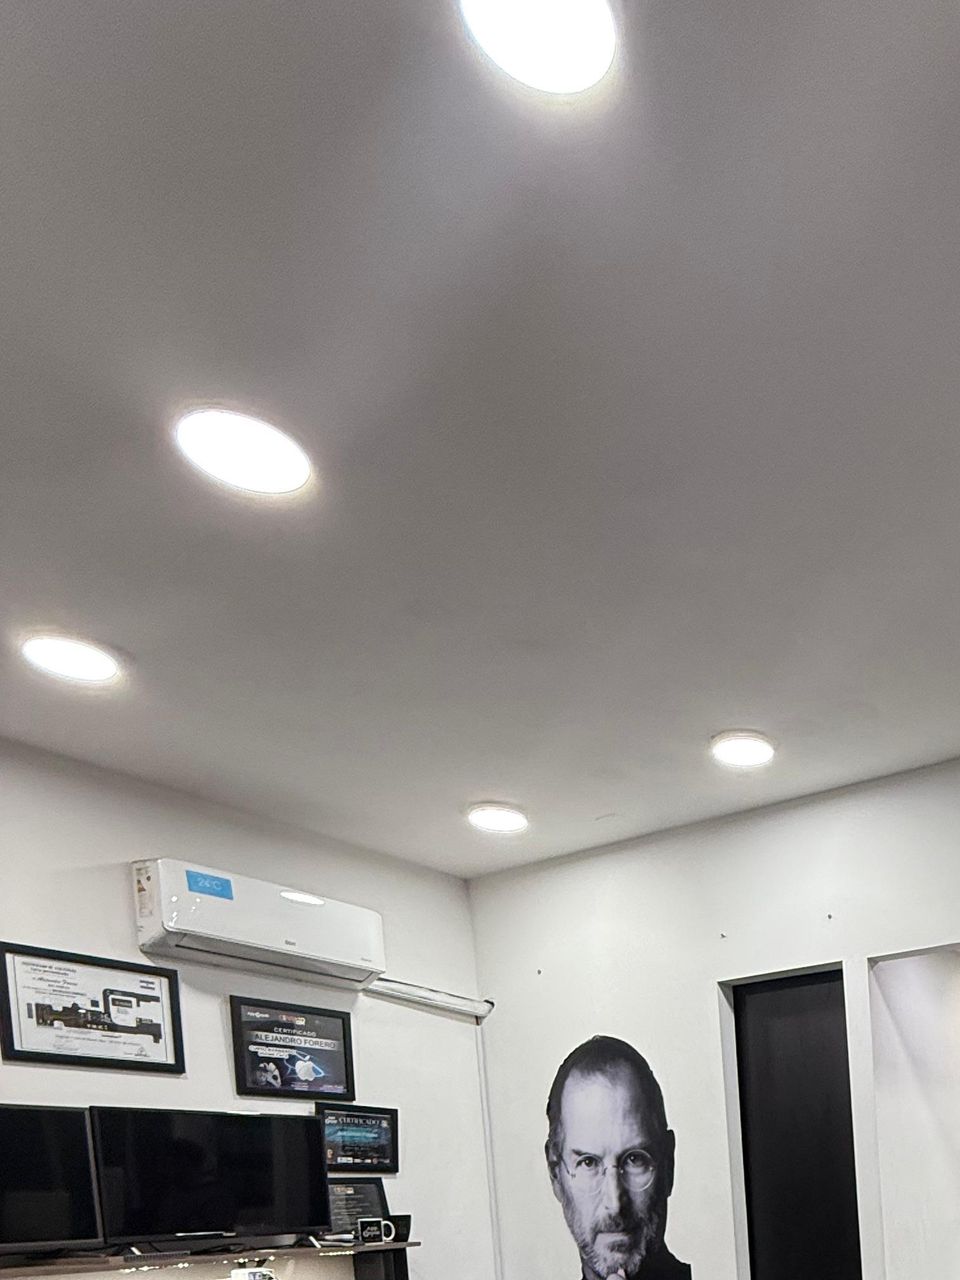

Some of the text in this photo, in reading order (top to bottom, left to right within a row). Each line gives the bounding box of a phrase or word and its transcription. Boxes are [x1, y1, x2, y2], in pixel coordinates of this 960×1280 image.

[273, 1027, 317, 1038] CERTIFICADO
[254, 1033, 336, 1049] ALEJANDRO FORERO
